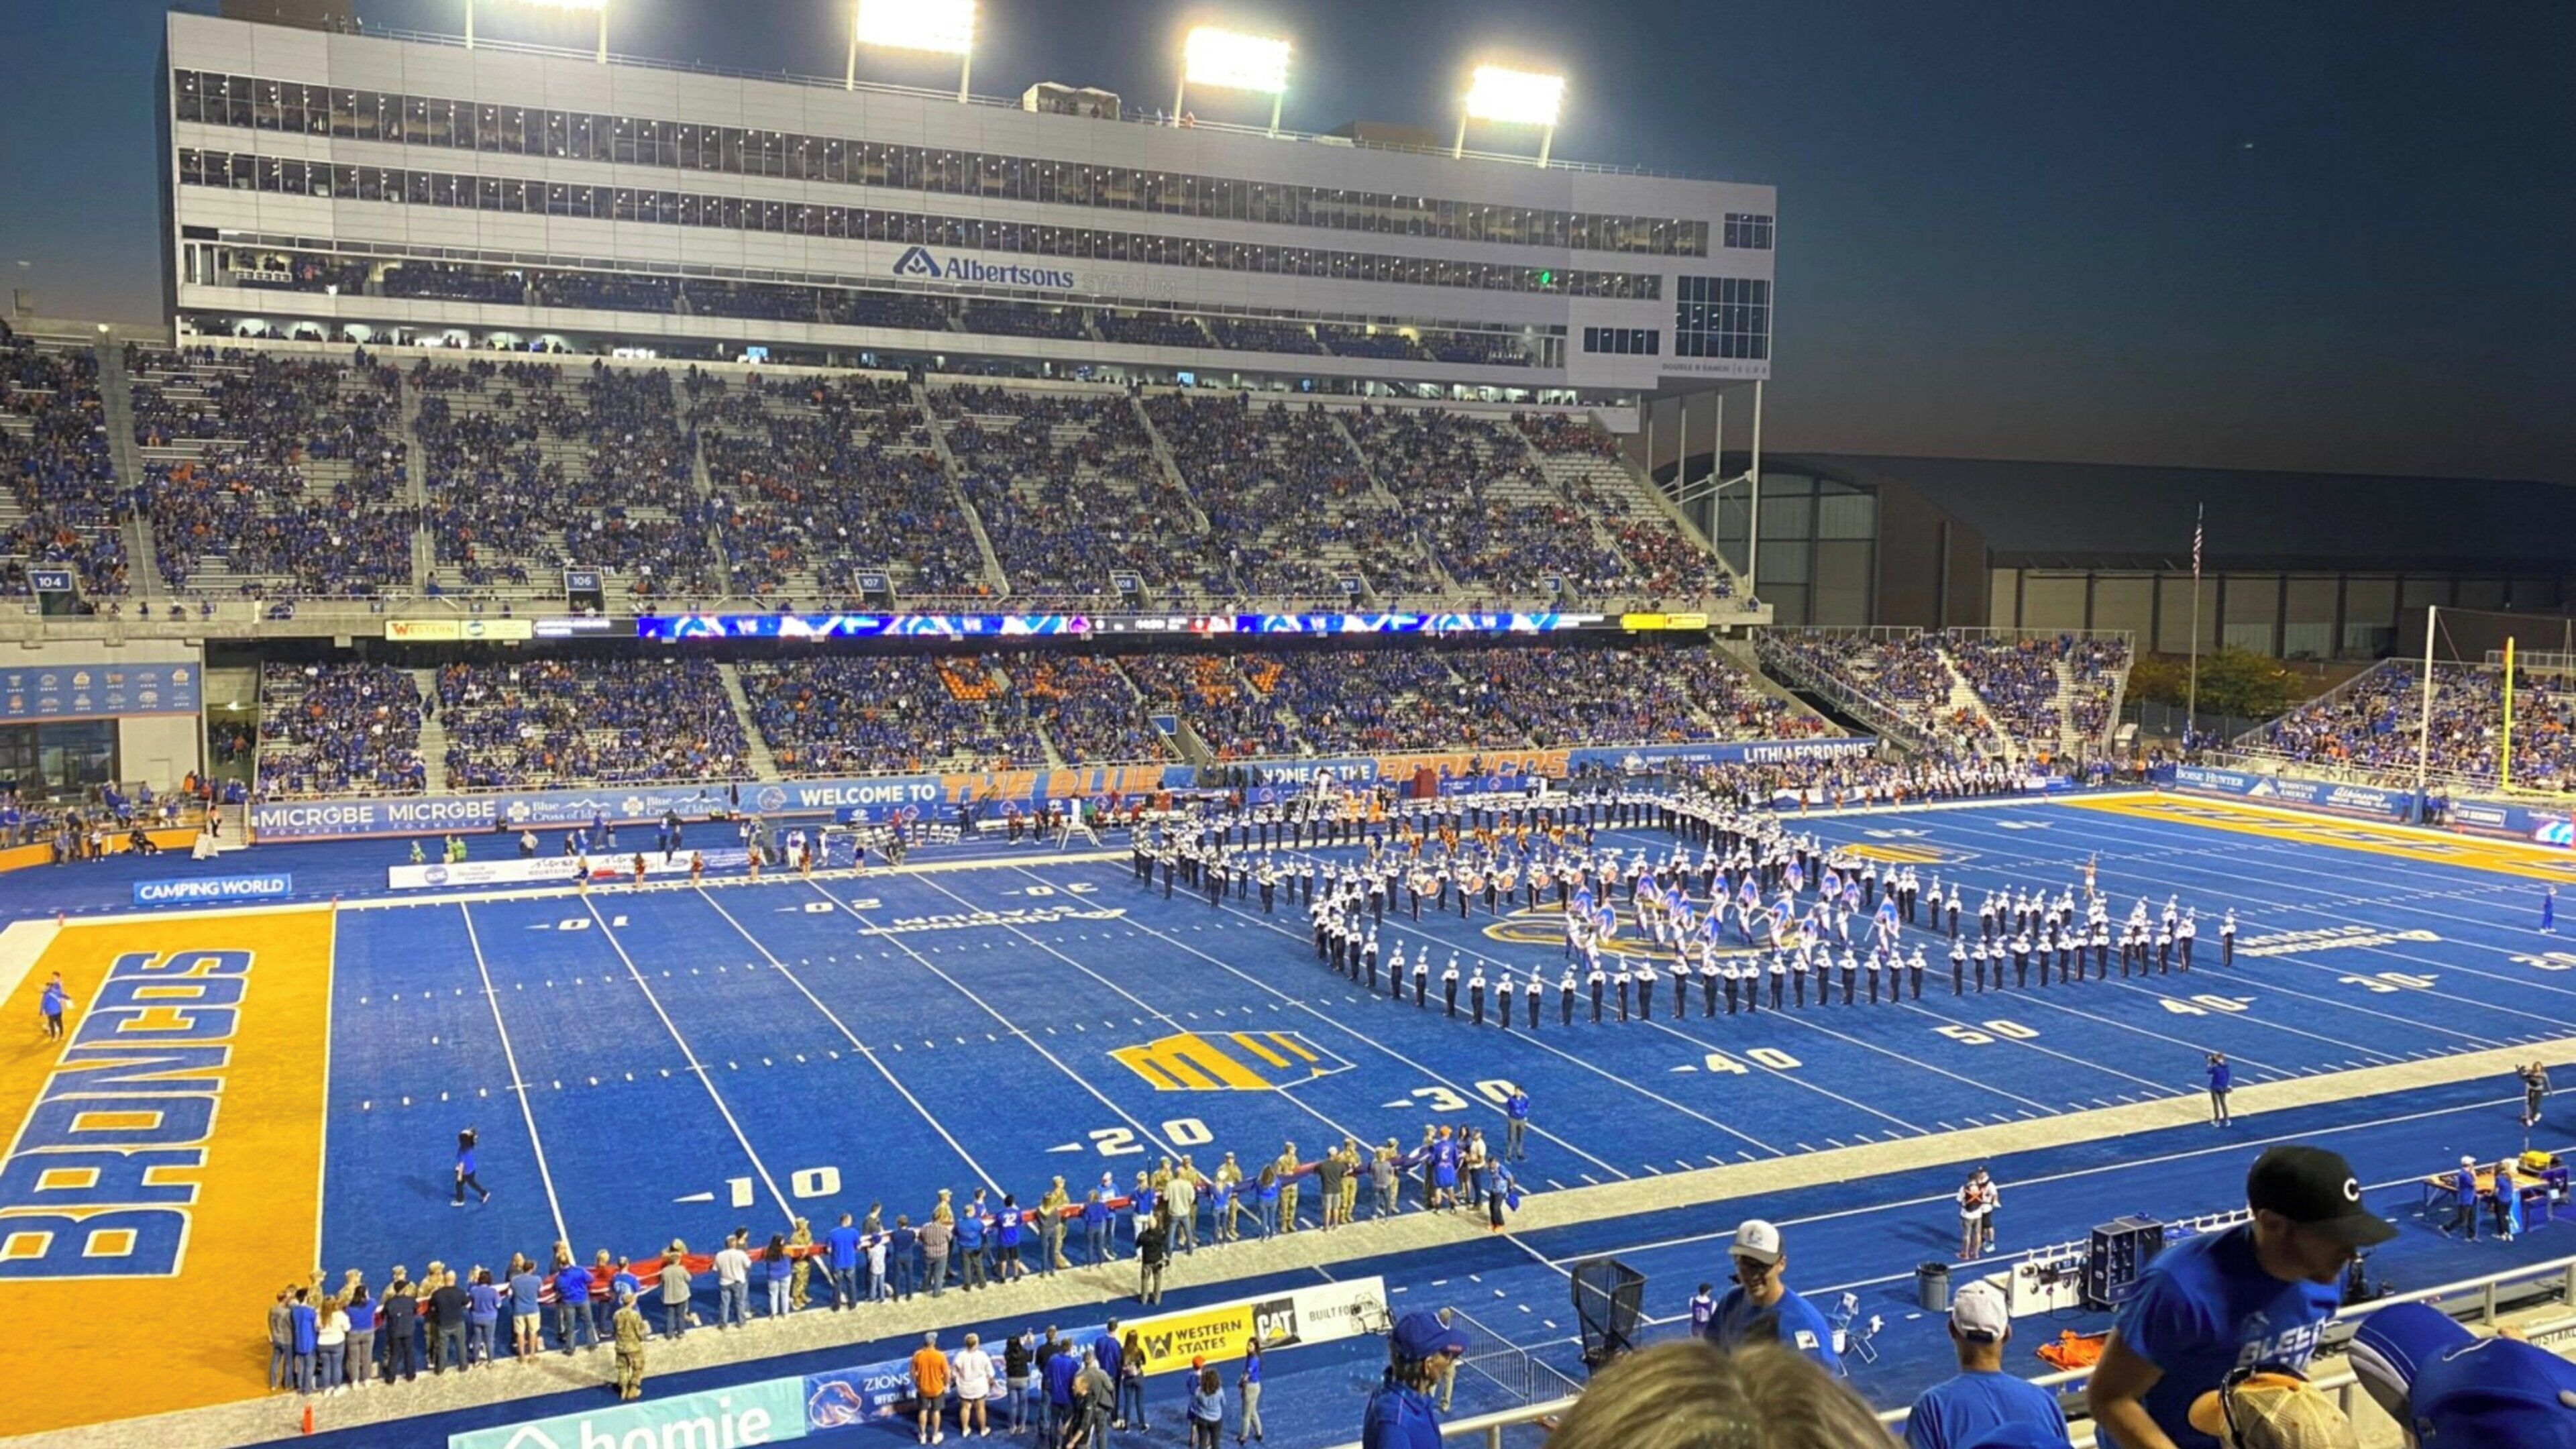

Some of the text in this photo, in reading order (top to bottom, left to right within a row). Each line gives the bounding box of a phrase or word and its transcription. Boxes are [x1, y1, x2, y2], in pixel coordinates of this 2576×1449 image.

[944, 258, 1177, 297] Albertsons STADIUM
[38, 577, 61, 587] 104
[574, 577, 591, 586] 106
[863, 578, 879, 587] 107
[391, 623, 455, 636] WESTERN
[1339, 765, 1370, 780] THE
[1375, 750, 1571, 782] BRONCOS
[799, 784, 936, 807] WELCOME TO
[941, 765, 1165, 803] THE BLUE
[532, 802, 559, 812] Blue
[646, 796, 672, 806] Blue
[260, 800, 496, 828] MICROBE MICROBE
[533, 811, 568, 822] Cross
[569, 810, 580, 820] of
[140, 879, 284, 900] CAMPING WORLD
[2338, 971, 2432, 994] 30
[2159, 994, 2250, 1016] 40
[1932, 1019, 2040, 1045] 50
[1704, 1046, 1803, 1075] 40
[1410, 1079, 1528, 1112] 30
[0, 948, 256, 1282] BRONCOS
[1087, 1118, 1214, 1157] 20
[724, 1166, 841, 1208] 10
[2343, 1177, 2360, 1202] C
[1256, 1309, 1295, 1340] CAT
[1309, 1306, 1336, 1322] BUILT
[1175, 1319, 1242, 1341] WESTERN
[1177, 1336, 1227, 1356] STATES
[863, 1372, 911, 1392] ZIONS
[580, 1397, 773, 1449] homie
